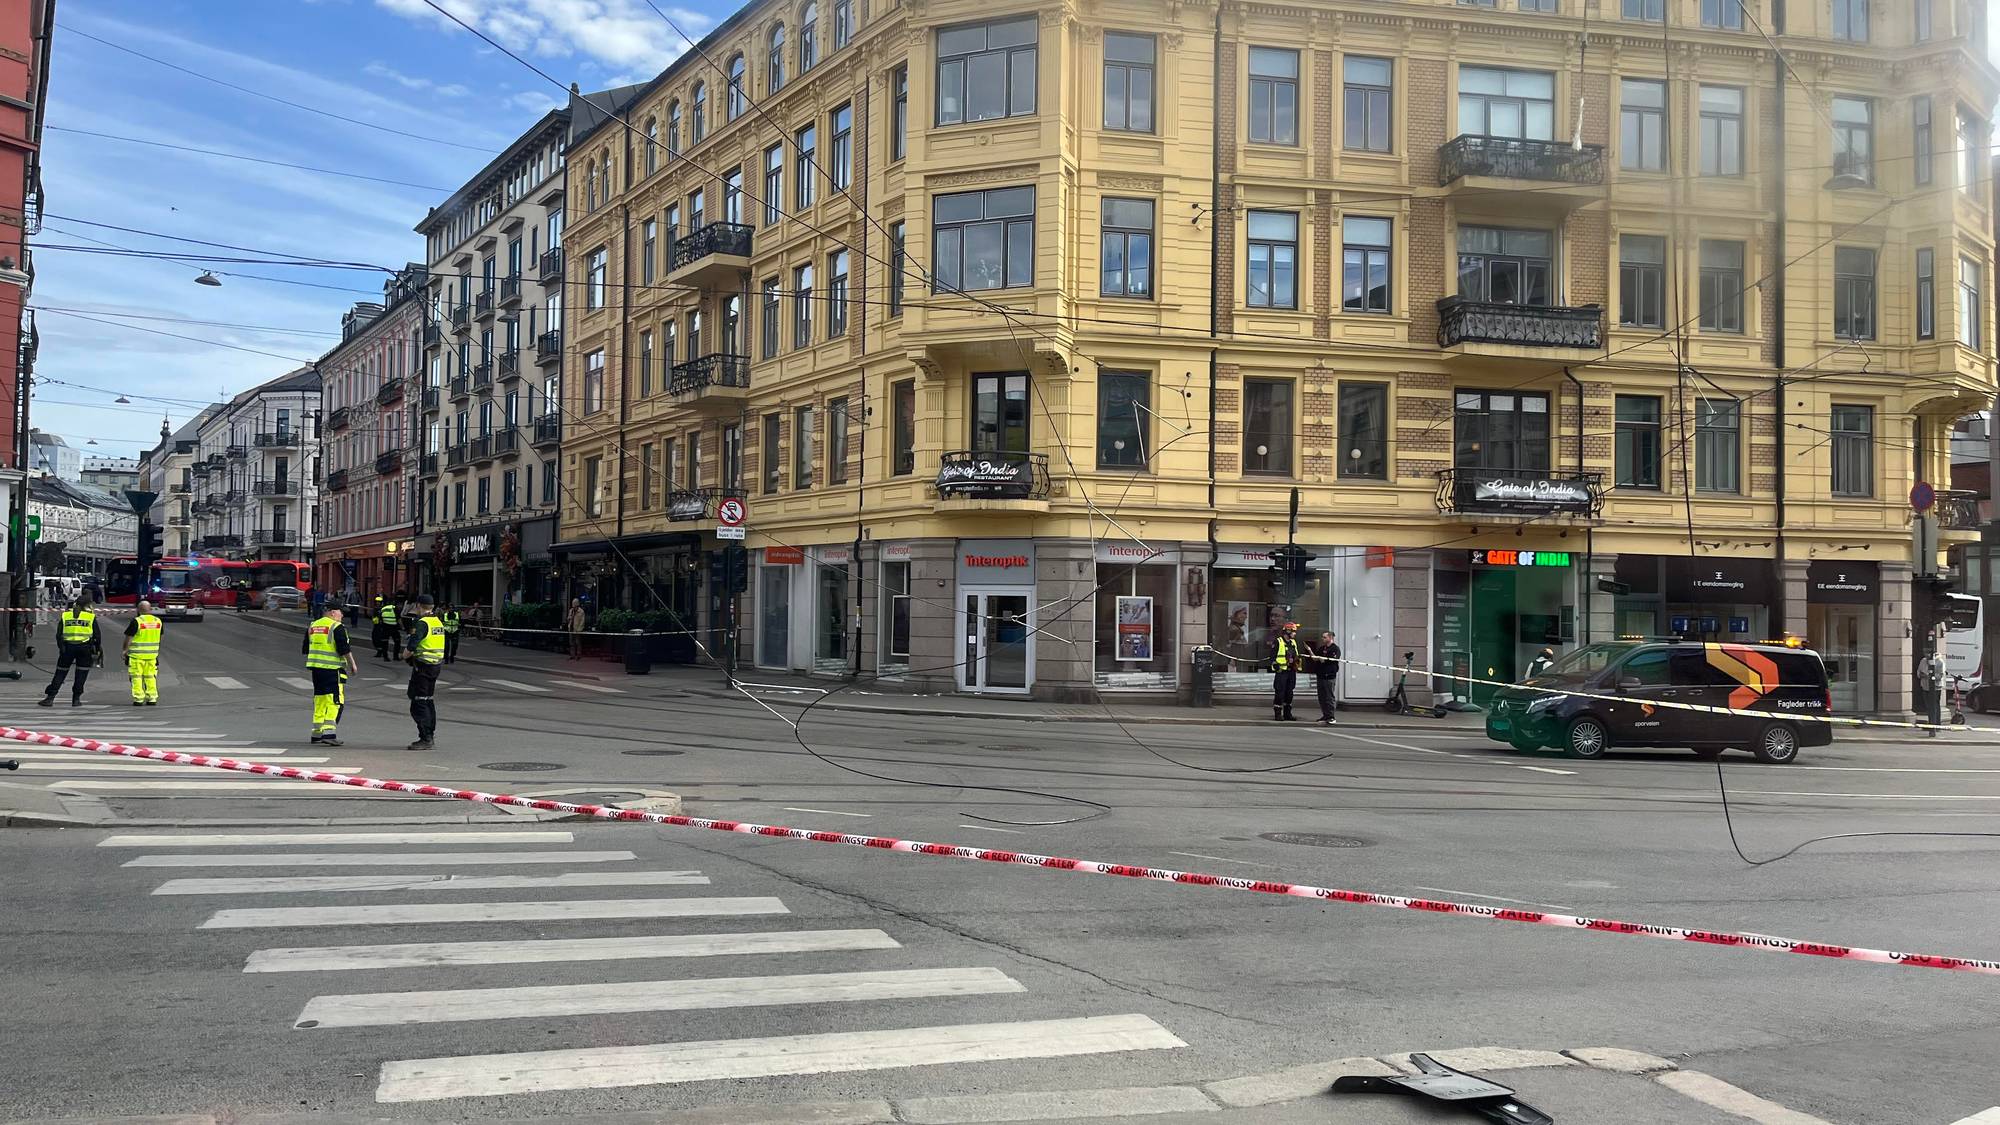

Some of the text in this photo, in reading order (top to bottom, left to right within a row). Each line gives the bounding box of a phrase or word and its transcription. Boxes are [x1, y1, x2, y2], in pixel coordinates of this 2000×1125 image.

[980, 461, 1019, 475] India
[1487, 479, 1575, 497] Gate of India
[459, 536, 470, 554] LOS
[1487, 551, 1570, 567] GATE OF INDIA
[1777, 700, 1822, 708] Fagleder trikk
[750, 826, 771, 835] OSLO
[806, 832, 818, 840] OG
[911, 843, 934, 853] OSLO
[975, 850, 988, 860] OG
[991, 851, 1075, 869] REDNINGSETATEN
[1097, 864, 1123, 874] OSLO
[1172, 872, 1187, 882] OG
